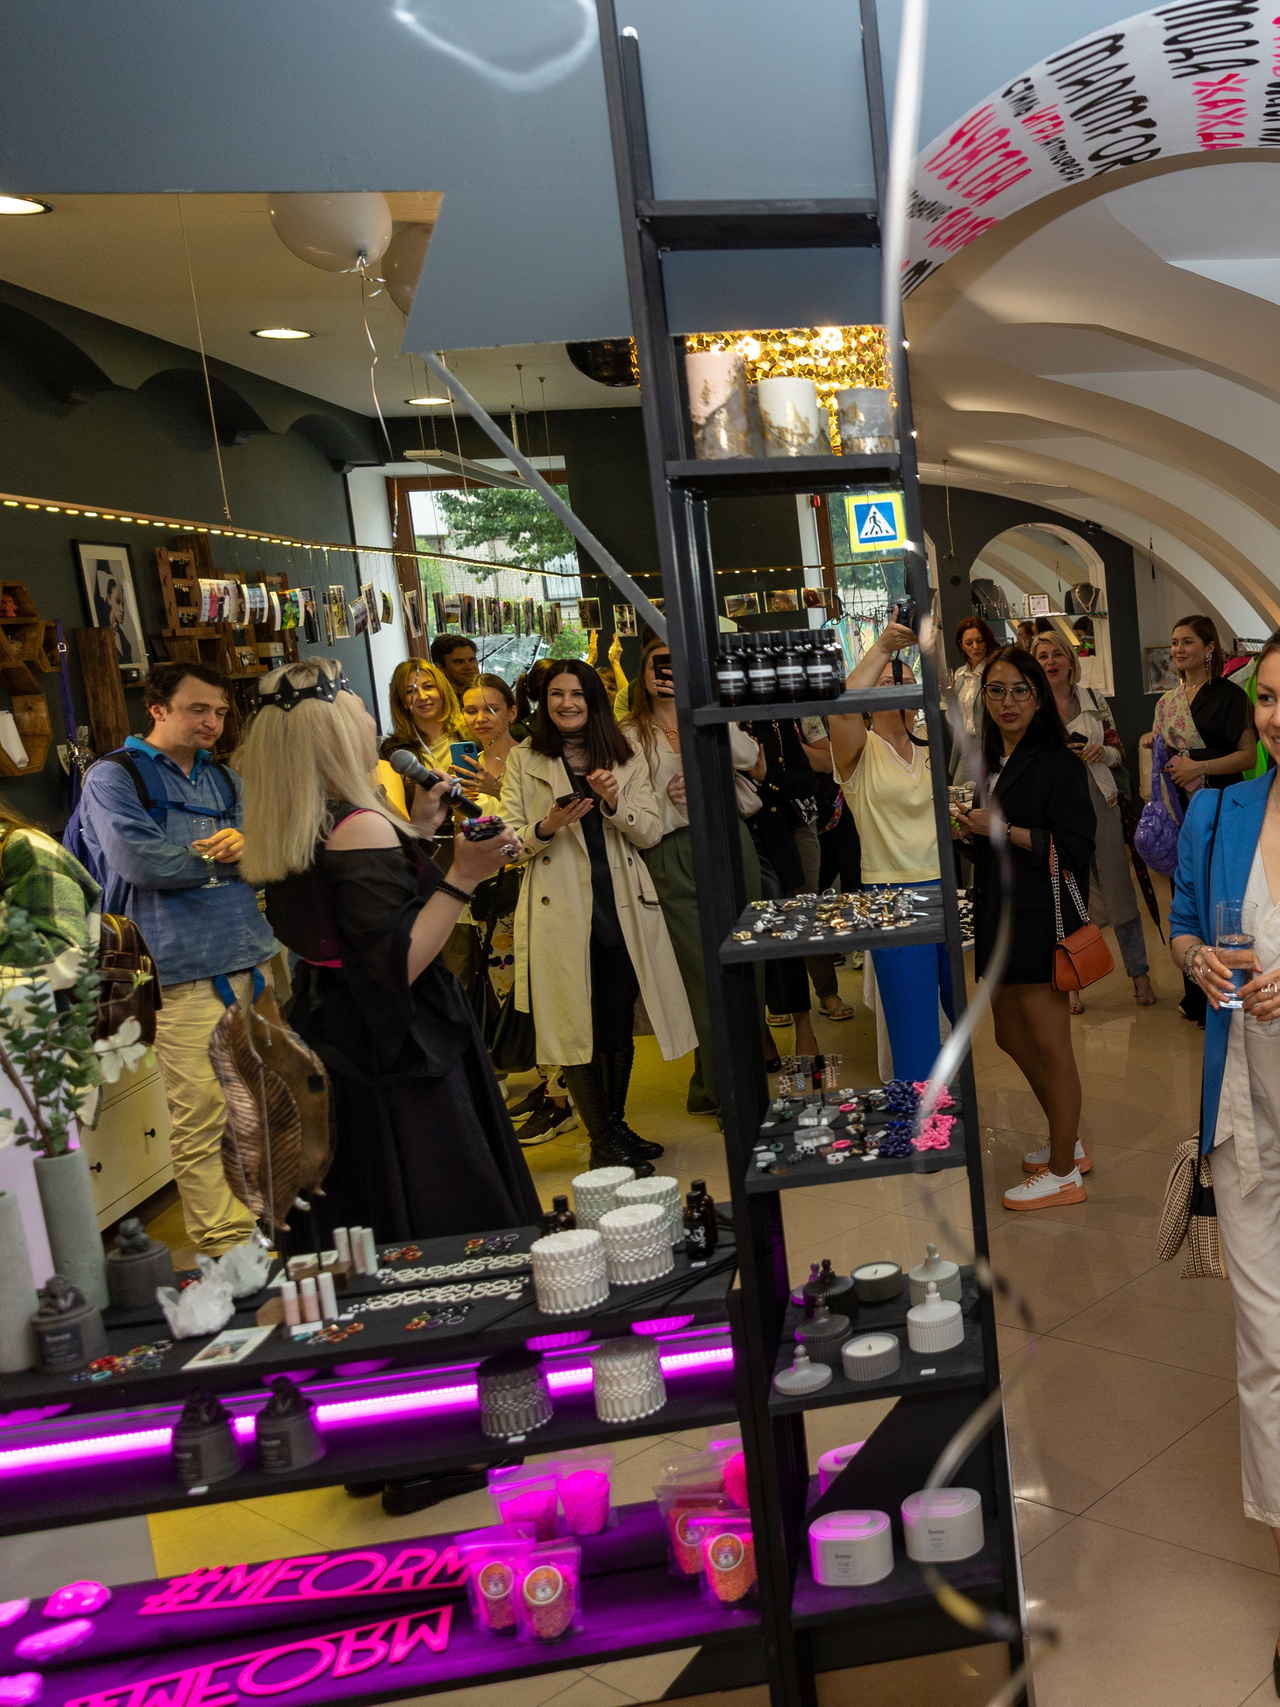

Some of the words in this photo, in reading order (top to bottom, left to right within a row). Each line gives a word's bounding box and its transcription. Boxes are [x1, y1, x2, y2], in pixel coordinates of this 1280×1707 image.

[1152, 0, 1260, 79] МОДА
[1001, 77, 1041, 118] СТИЛЬ
[1020, 103, 1056, 144] ИГРА
[1191, 73, 1250, 152] ЖАЖДА
[922, 103, 1032, 208] ЧУВСТВА
